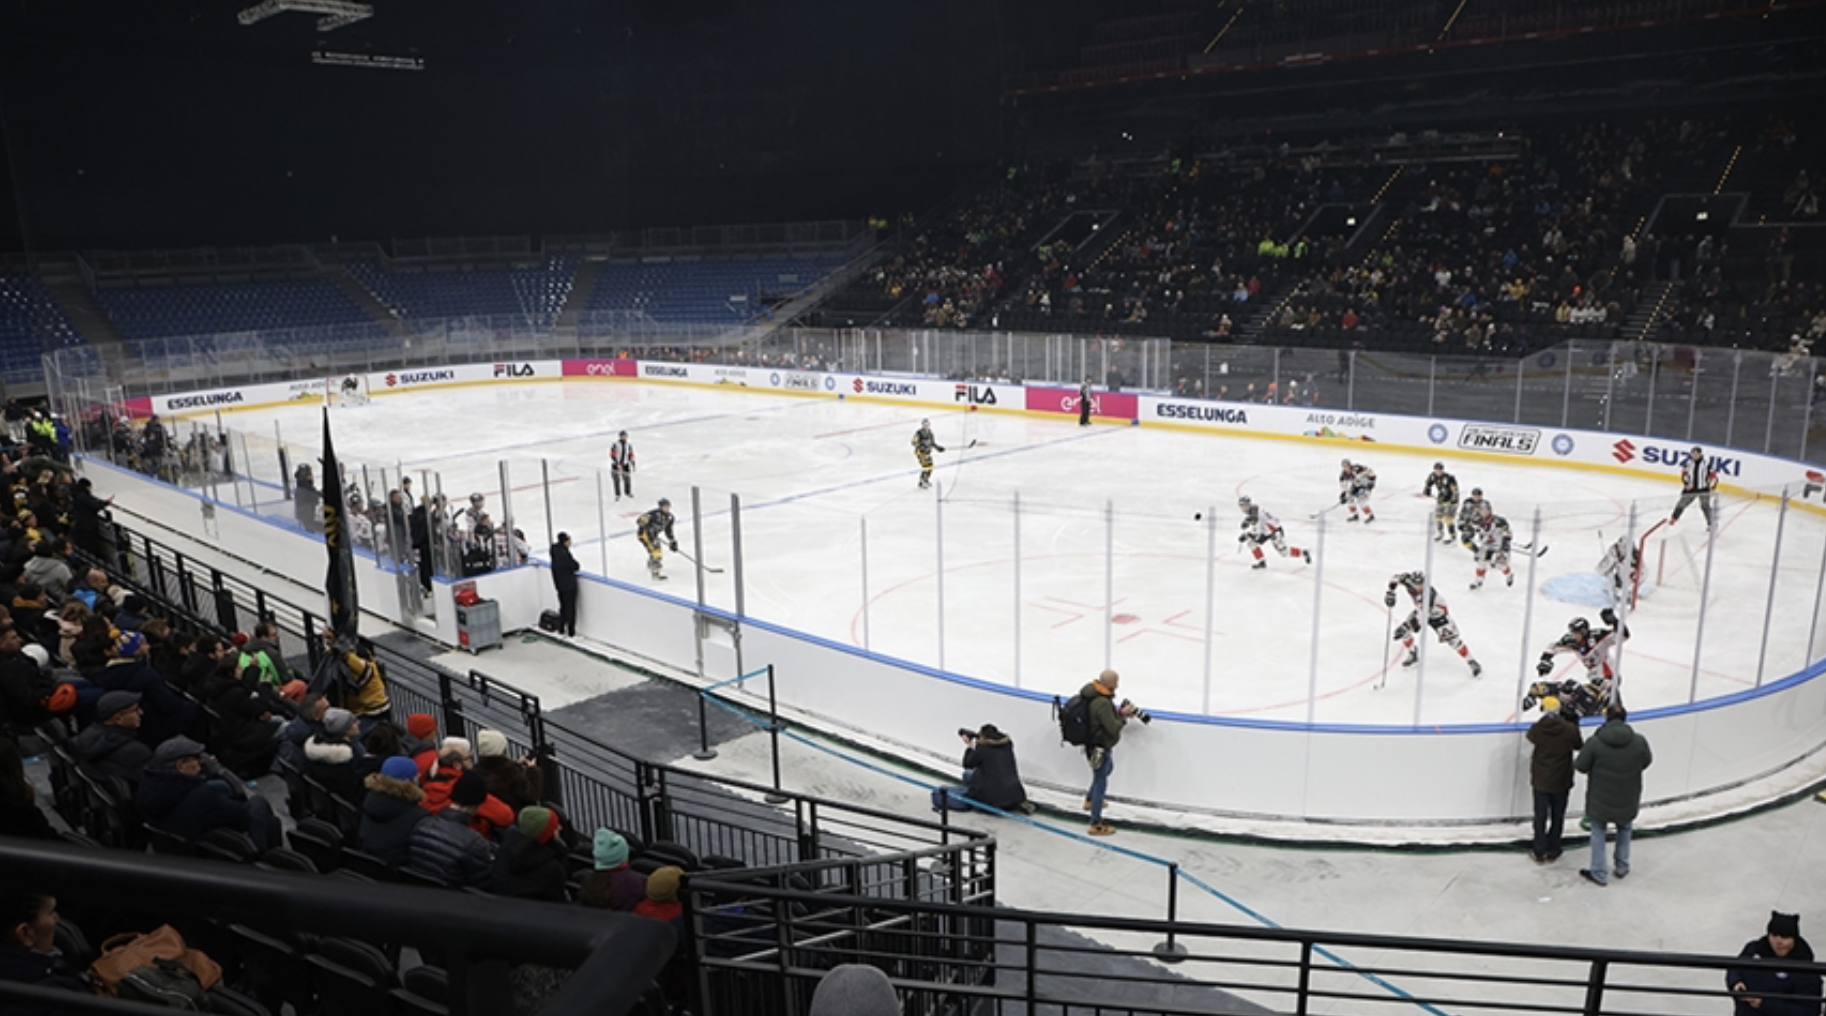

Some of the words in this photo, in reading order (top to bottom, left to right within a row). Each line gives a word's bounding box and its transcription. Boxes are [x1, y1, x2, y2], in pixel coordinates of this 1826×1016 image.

[400, 370, 454, 384] SUZUKI
[493, 363, 535, 378] FILA
[645, 365, 688, 378] ESSELUNGA
[866, 381, 917, 396] SUZUKI
[955, 384, 997, 404] FILA
[167, 391, 244, 410] ESSELUNGA
[1156, 403, 1248, 424] ESSELUNGA
[1337, 414, 1376, 429] ADIGE
[1463, 432, 1533, 451] FINALS
